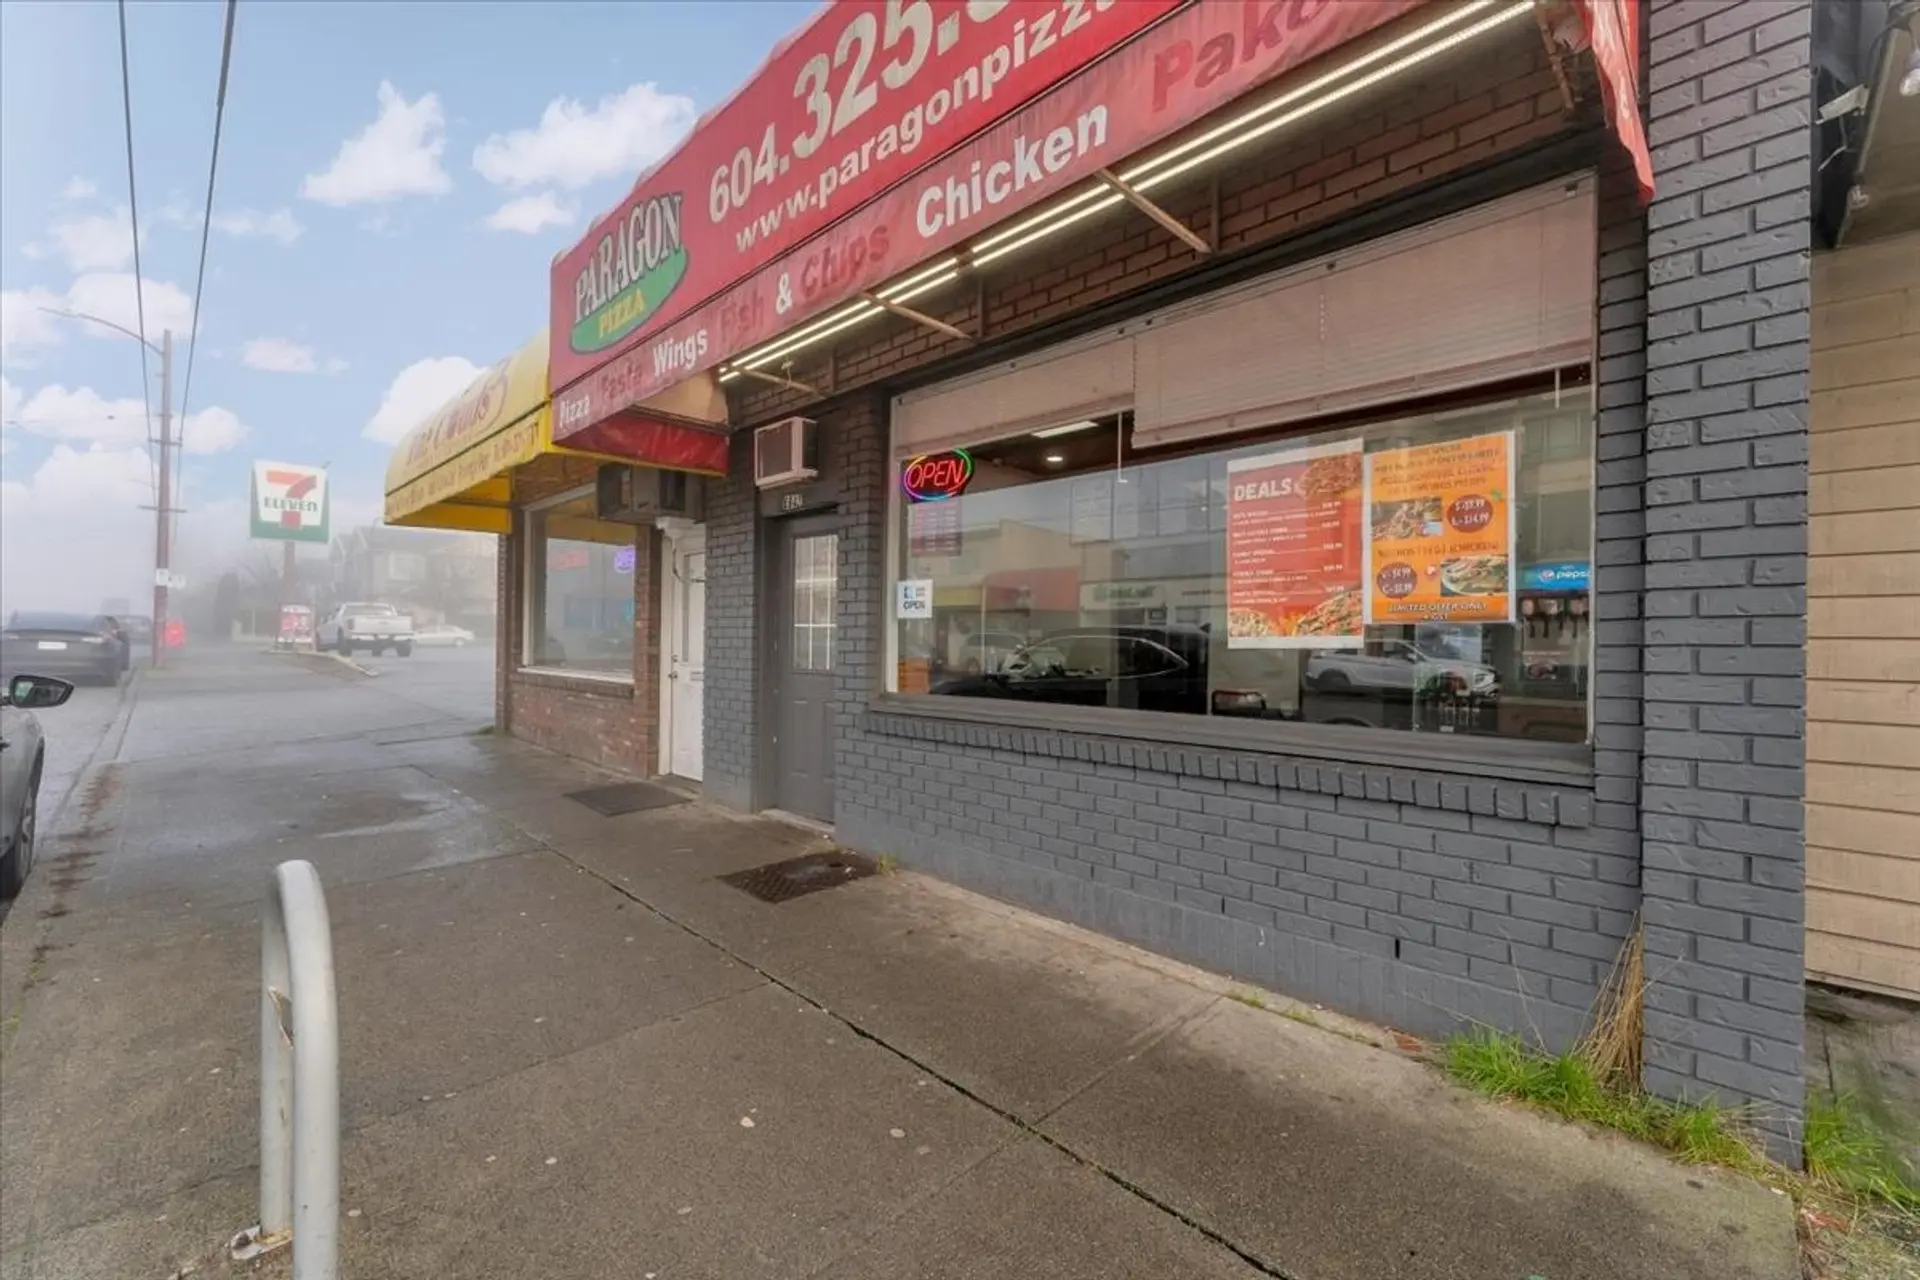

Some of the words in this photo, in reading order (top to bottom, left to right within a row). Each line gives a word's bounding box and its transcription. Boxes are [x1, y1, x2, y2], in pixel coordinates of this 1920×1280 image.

[574, 195, 682, 323] PARAGON
[653, 329, 709, 377] Wings
[776, 272, 793, 315] &
[802, 224, 890, 299] Chips
[916, 104, 1108, 238] Chicken
[599, 287, 645, 340] PIZZA
[266, 469, 318, 529] 7
[907, 459, 965, 488] OPEN
[1234, 478, 1293, 502] DEALS
